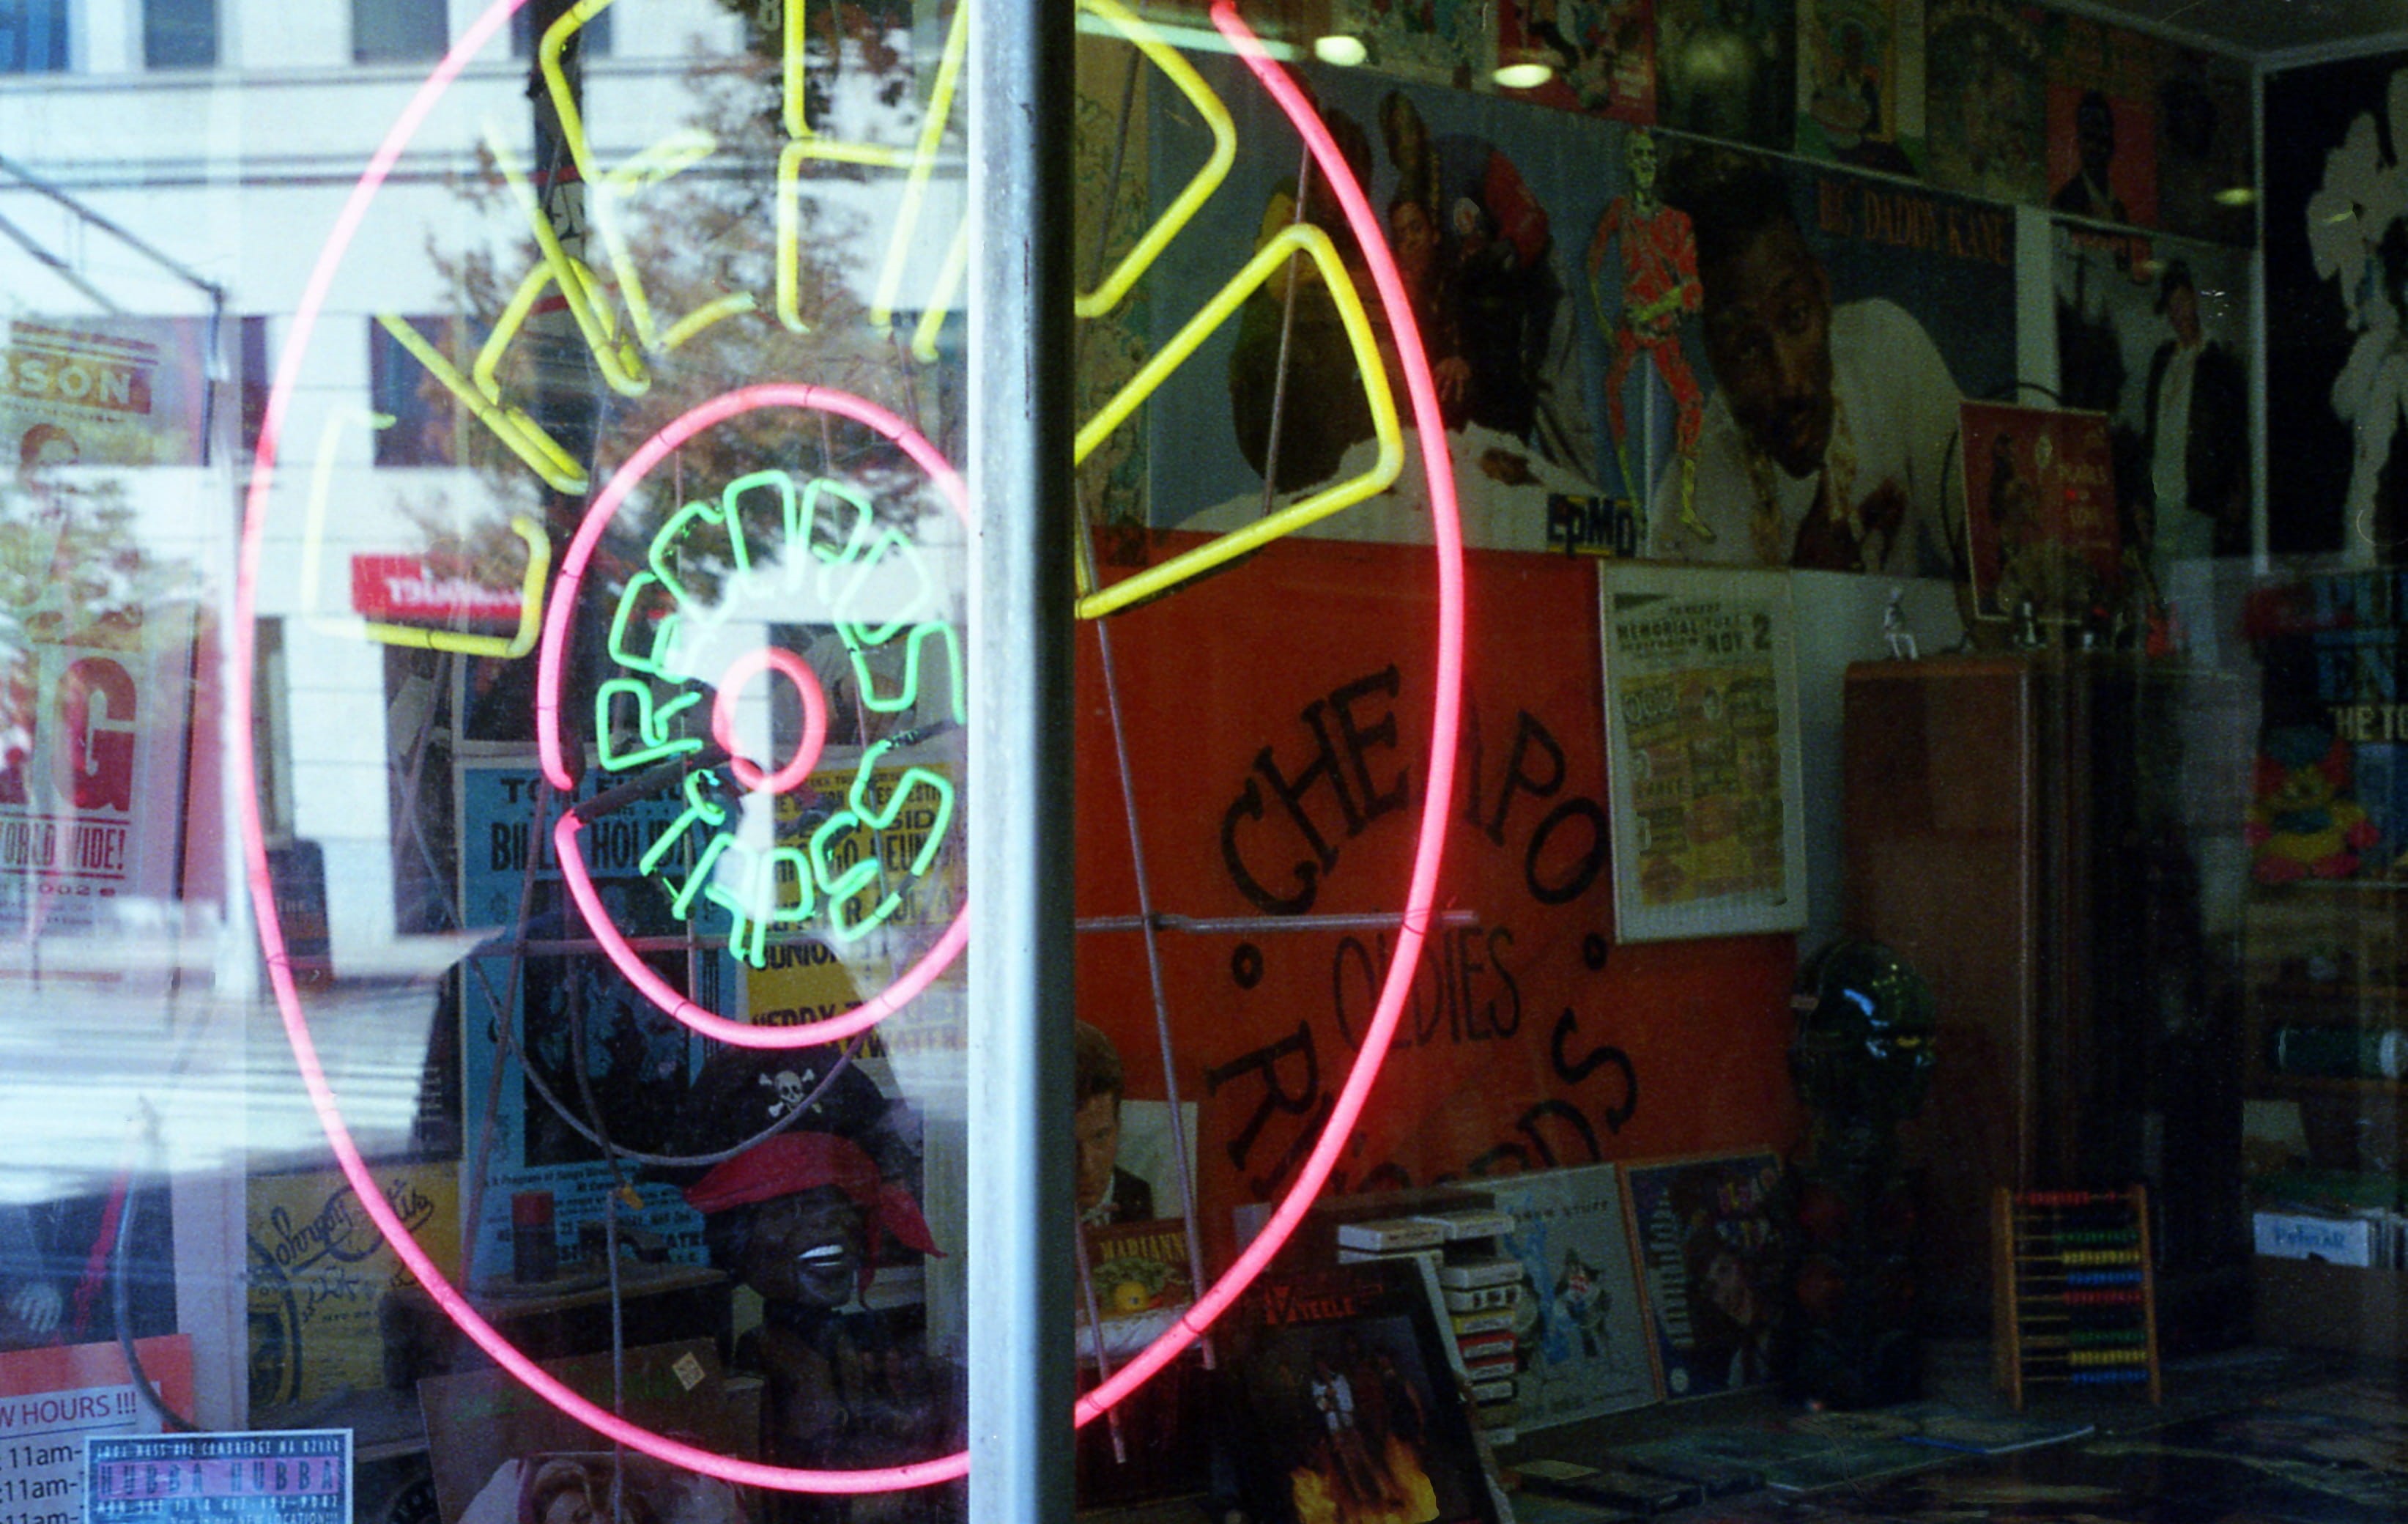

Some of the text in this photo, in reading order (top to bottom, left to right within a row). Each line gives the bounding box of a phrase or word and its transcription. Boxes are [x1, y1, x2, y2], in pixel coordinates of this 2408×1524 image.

[597, 470, 967, 772] RECORDS
[21, 1394, 111, 1425] HOURS
[116, 1391, 137, 1415] !!!
[100, 1460, 334, 1495] HUBBA HUBBA
